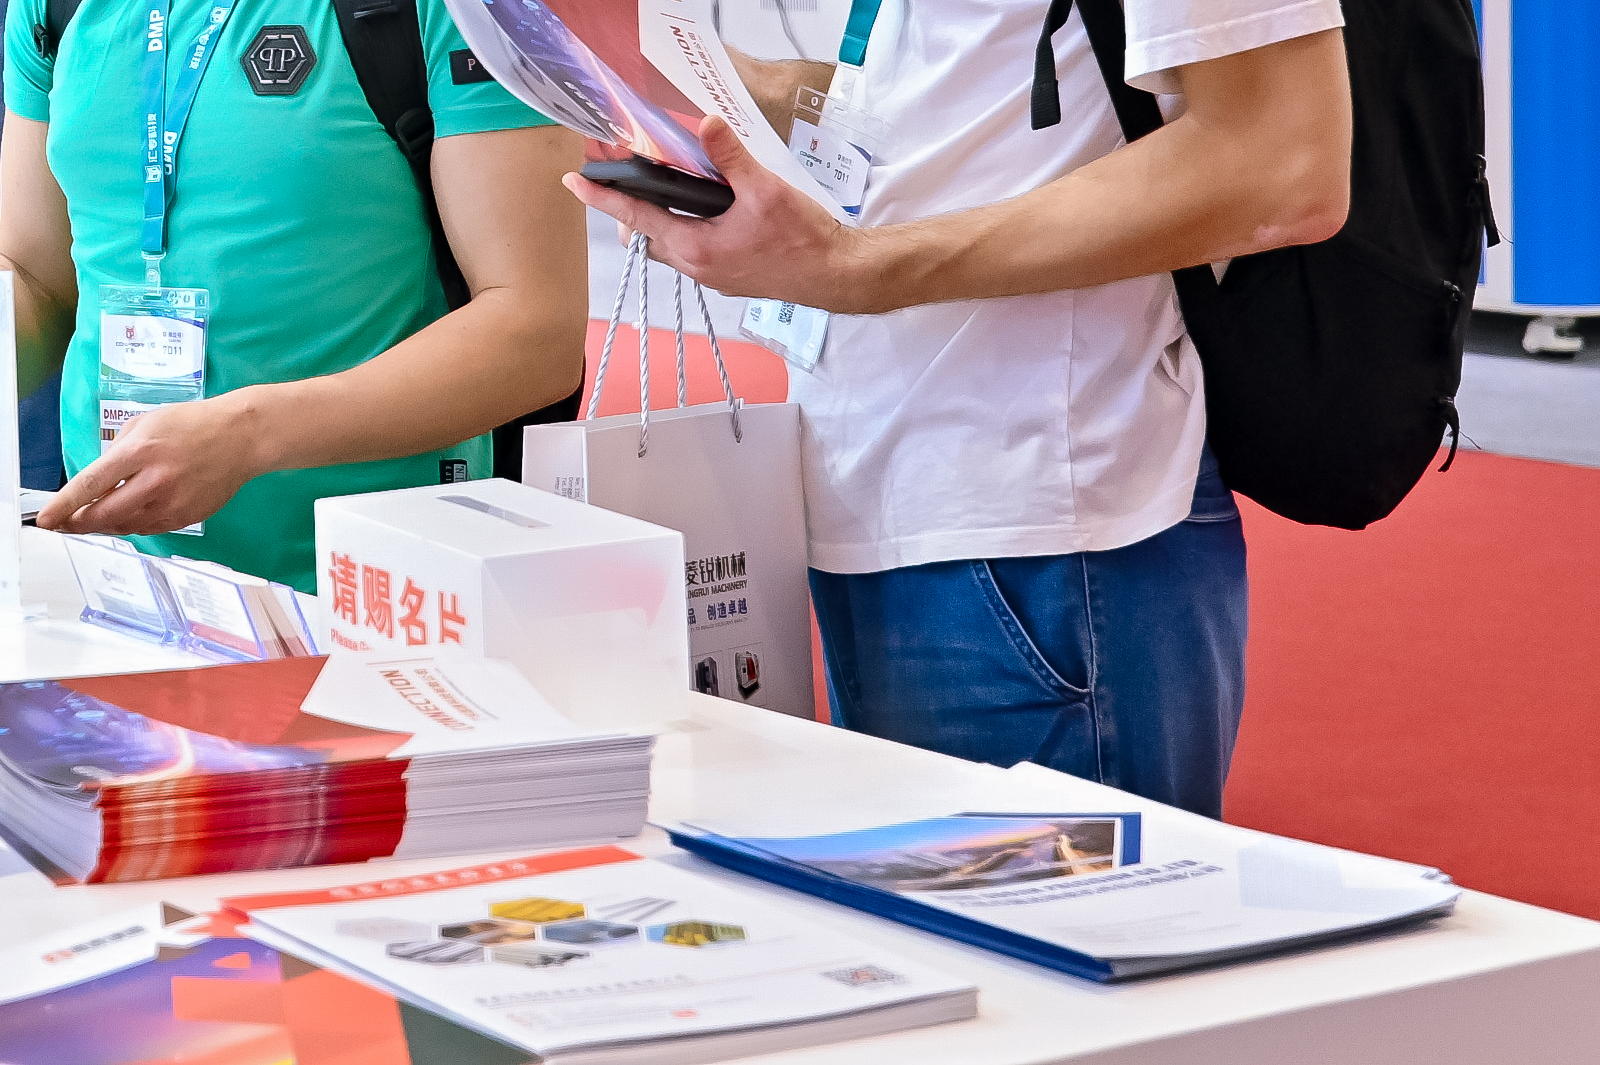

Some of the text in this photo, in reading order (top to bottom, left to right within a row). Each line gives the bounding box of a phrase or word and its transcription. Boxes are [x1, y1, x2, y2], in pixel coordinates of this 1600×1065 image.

[148, 10, 165, 52] DMP
[670, 25, 750, 138] CONNECTION
[103, 409, 123, 420] DMP
[329, 551, 466, 646] 请赐名片
[688, 579, 748, 599] INGRUI MACHINERY
[707, 598, 748, 620] 创造卓越
